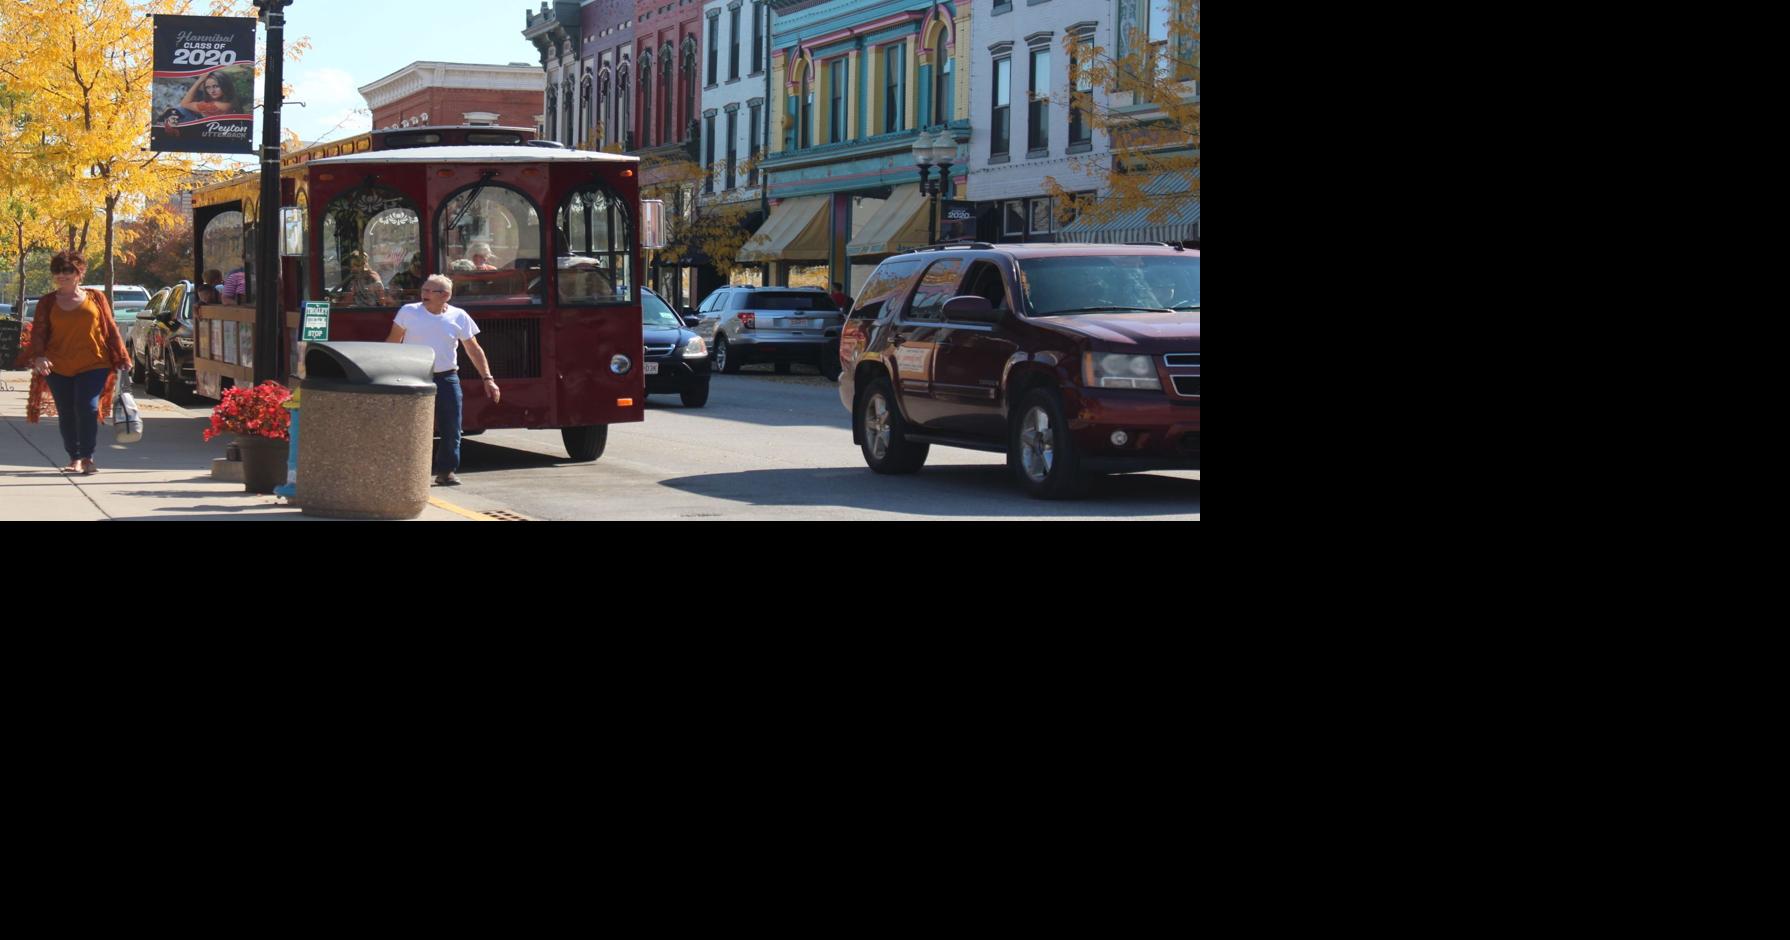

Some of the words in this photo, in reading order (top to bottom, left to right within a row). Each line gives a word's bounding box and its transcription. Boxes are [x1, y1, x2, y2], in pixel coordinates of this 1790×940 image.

[176, 31, 235, 43] Hannibal
[173, 49, 237, 65] 2020
[206, 121, 248, 136] Peyton
